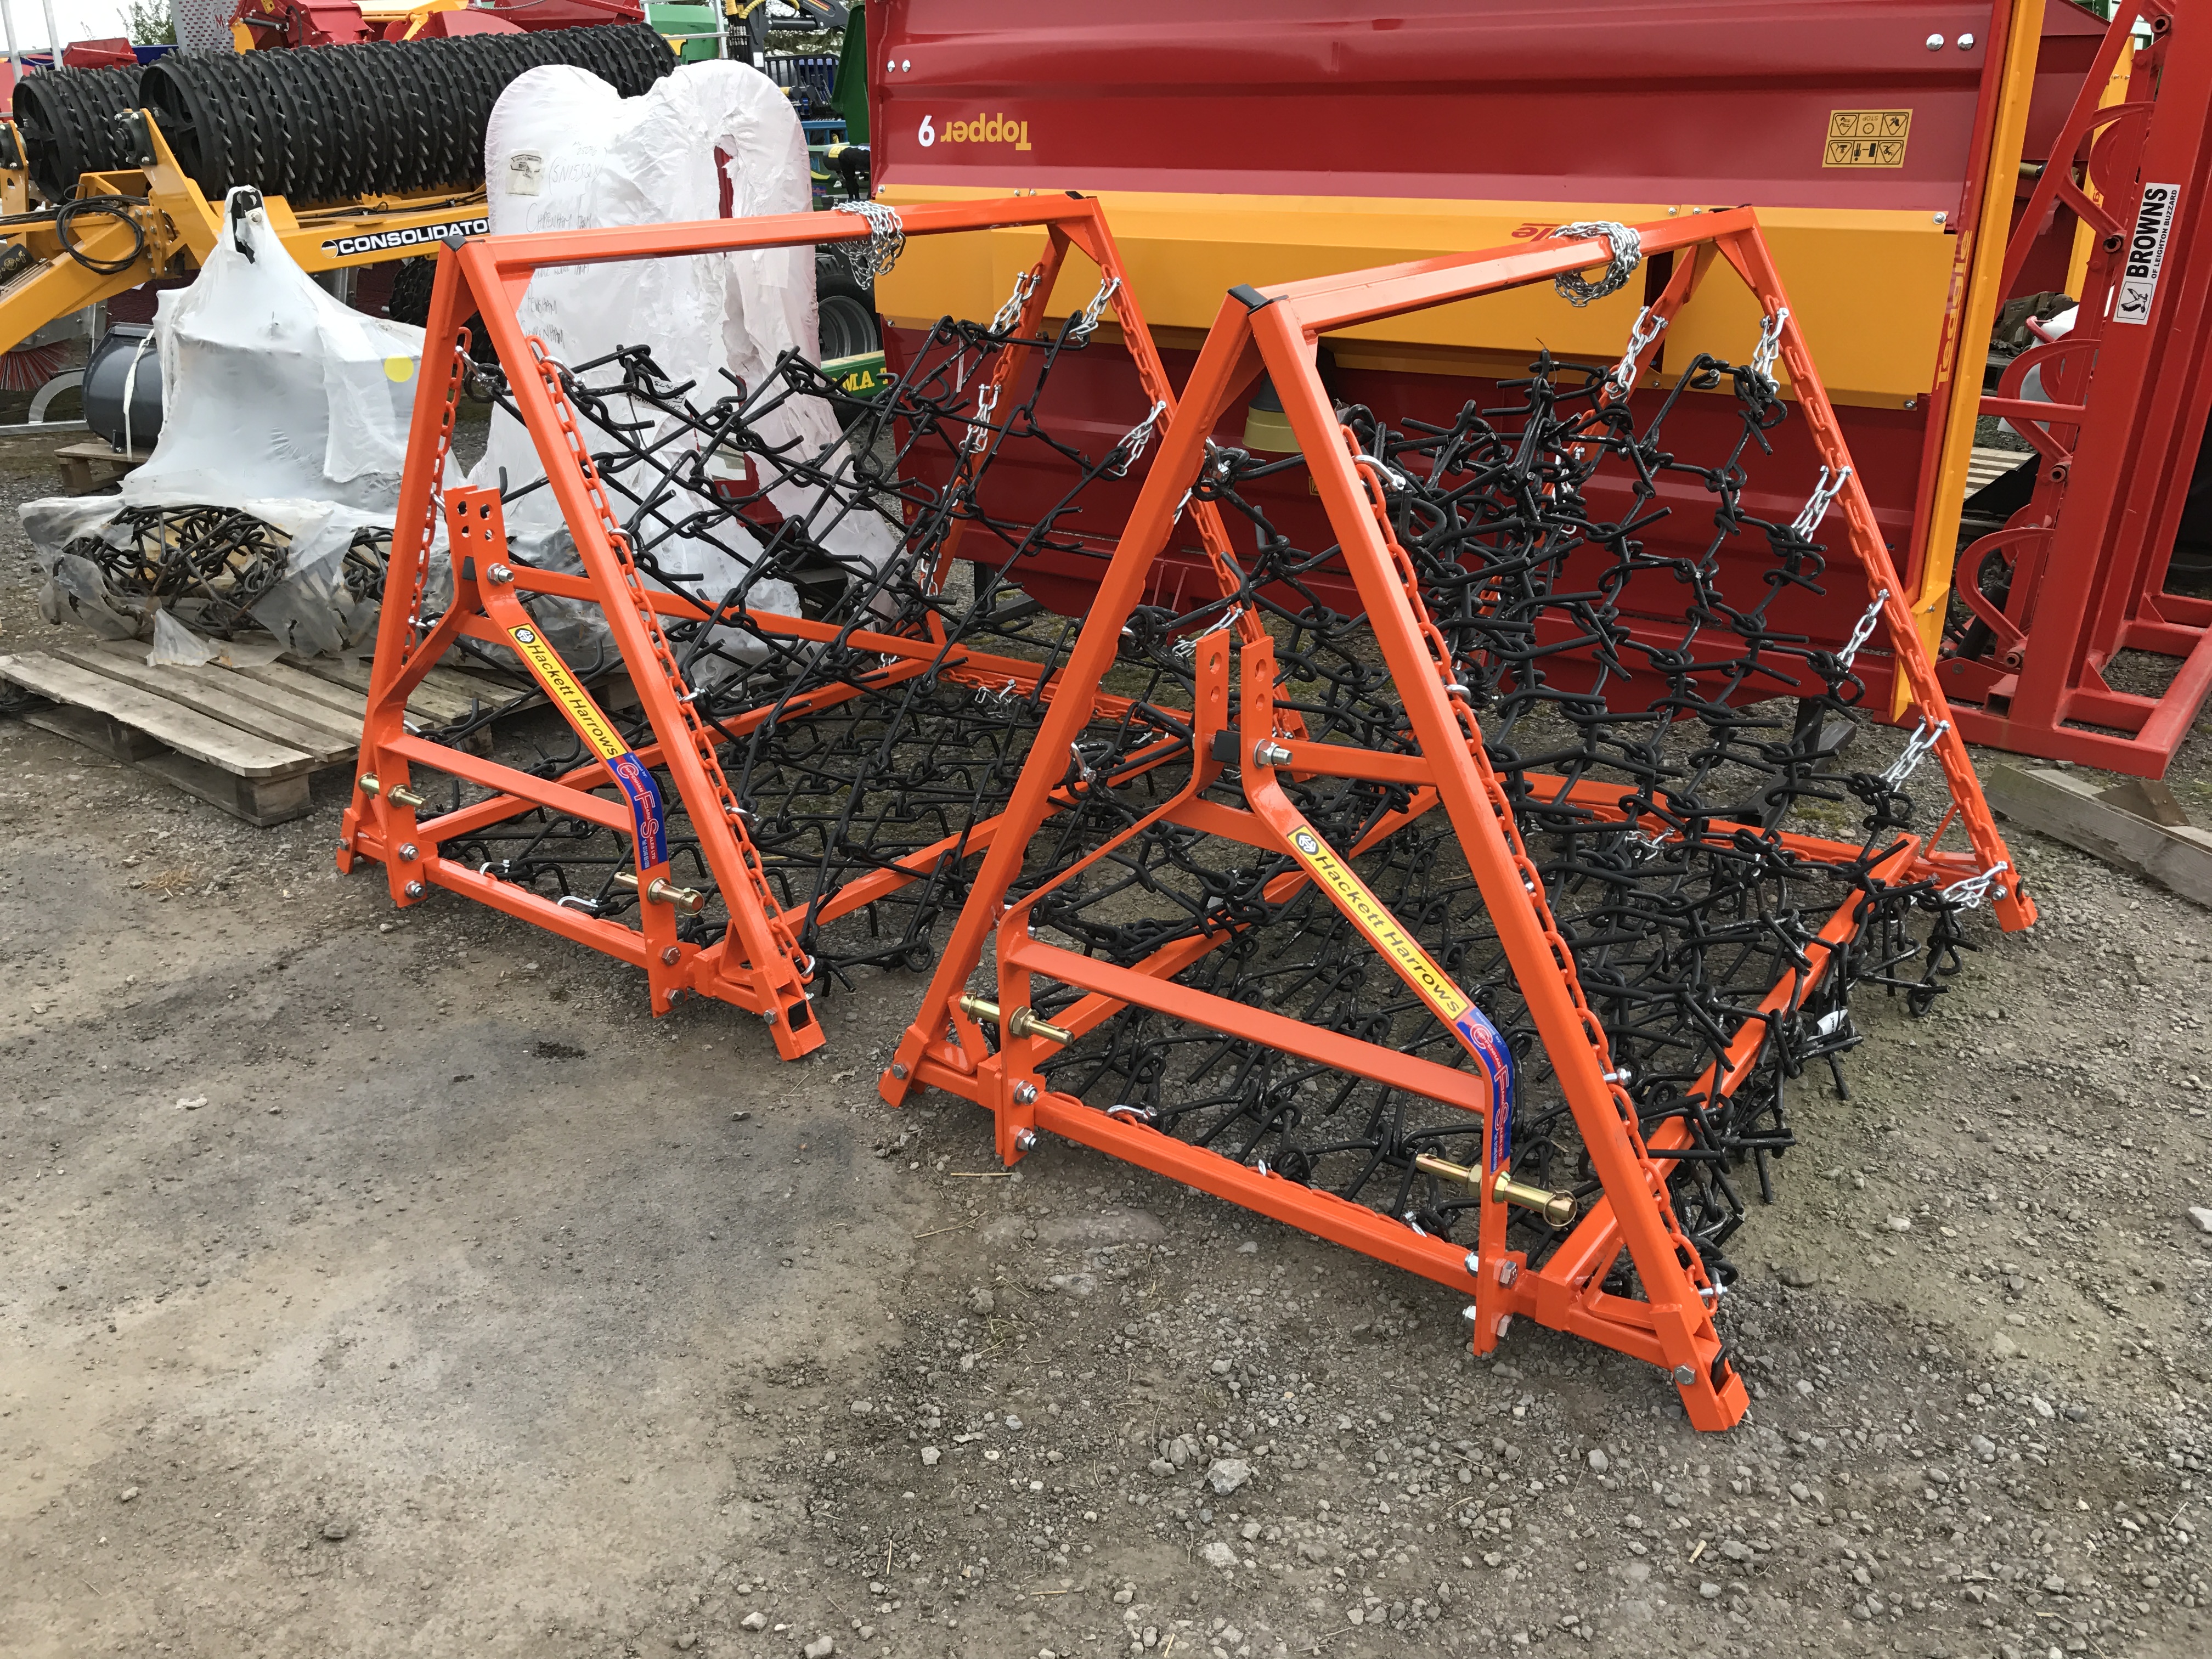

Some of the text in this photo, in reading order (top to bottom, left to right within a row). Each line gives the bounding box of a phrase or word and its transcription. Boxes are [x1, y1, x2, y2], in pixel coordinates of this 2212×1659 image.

[940, 113, 1031, 150] Topper
[338, 218, 490, 254] CONSOLIDATO
[2126, 188, 2168, 278] BROWNS
[2151, 189, 2177, 279] OF LEIGHTON BUZZARD
[527, 645, 619, 756] Hackett Harrows
[617, 762, 644, 793] CHIPPENHAM
[634, 790, 656, 821] FARM
[640, 818, 659, 850] SALES
[1314, 856, 1460, 1013] Hackett Harrows
[1470, 1024, 1502, 1069] CHIPPENHAM
[1494, 1064, 1509, 1105] FARM
[1494, 1102, 1509, 1143] SALES
